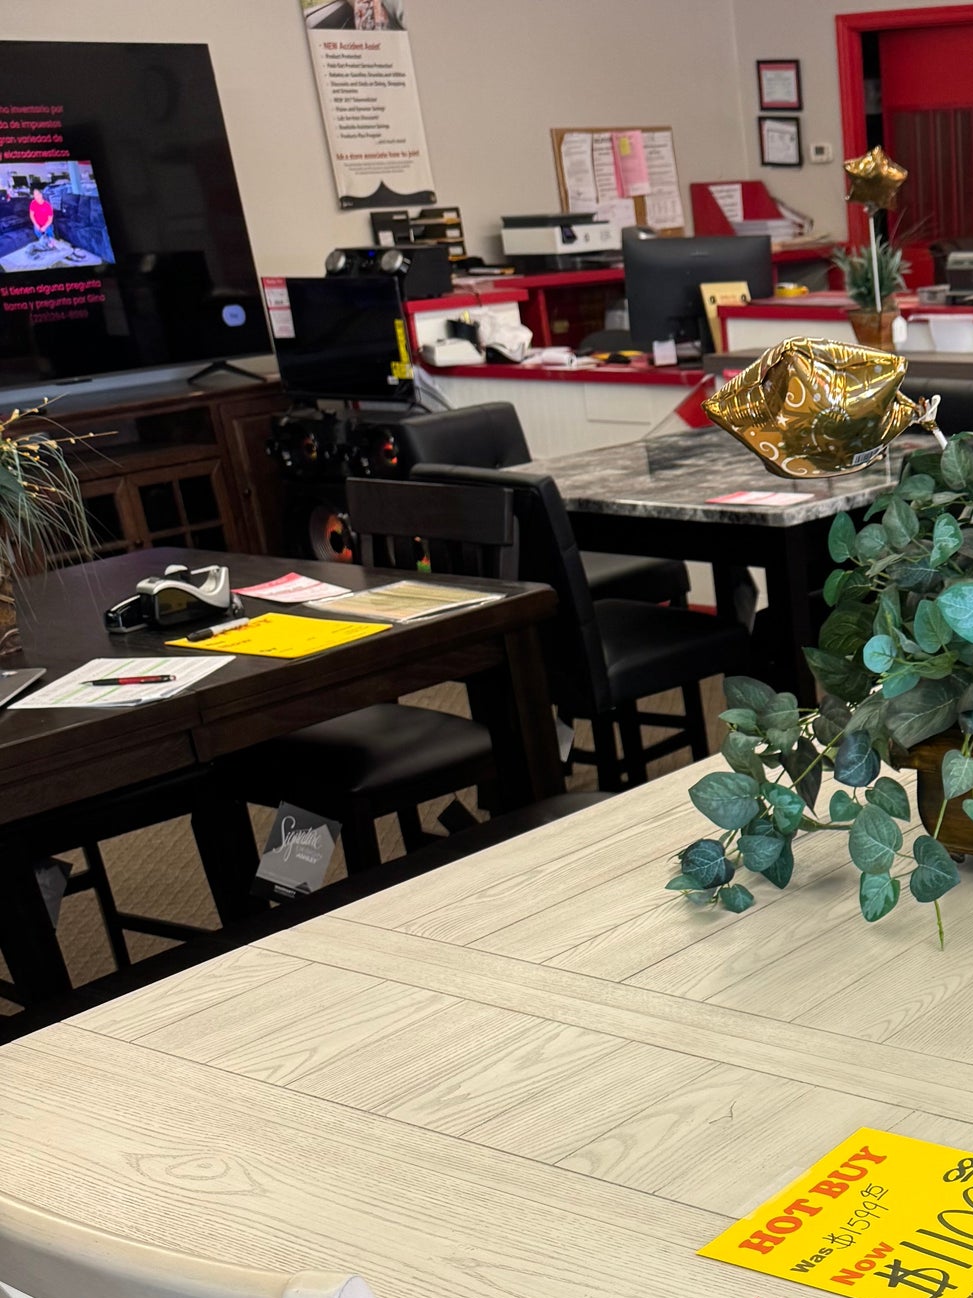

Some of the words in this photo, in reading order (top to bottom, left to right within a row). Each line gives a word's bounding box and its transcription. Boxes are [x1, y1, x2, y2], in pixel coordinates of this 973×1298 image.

[738, 1198, 823, 1255] HOT
[808, 1145, 888, 1199] BUY
[790, 1246, 834, 1273] Was
[830, 1241, 894, 1286] Now
